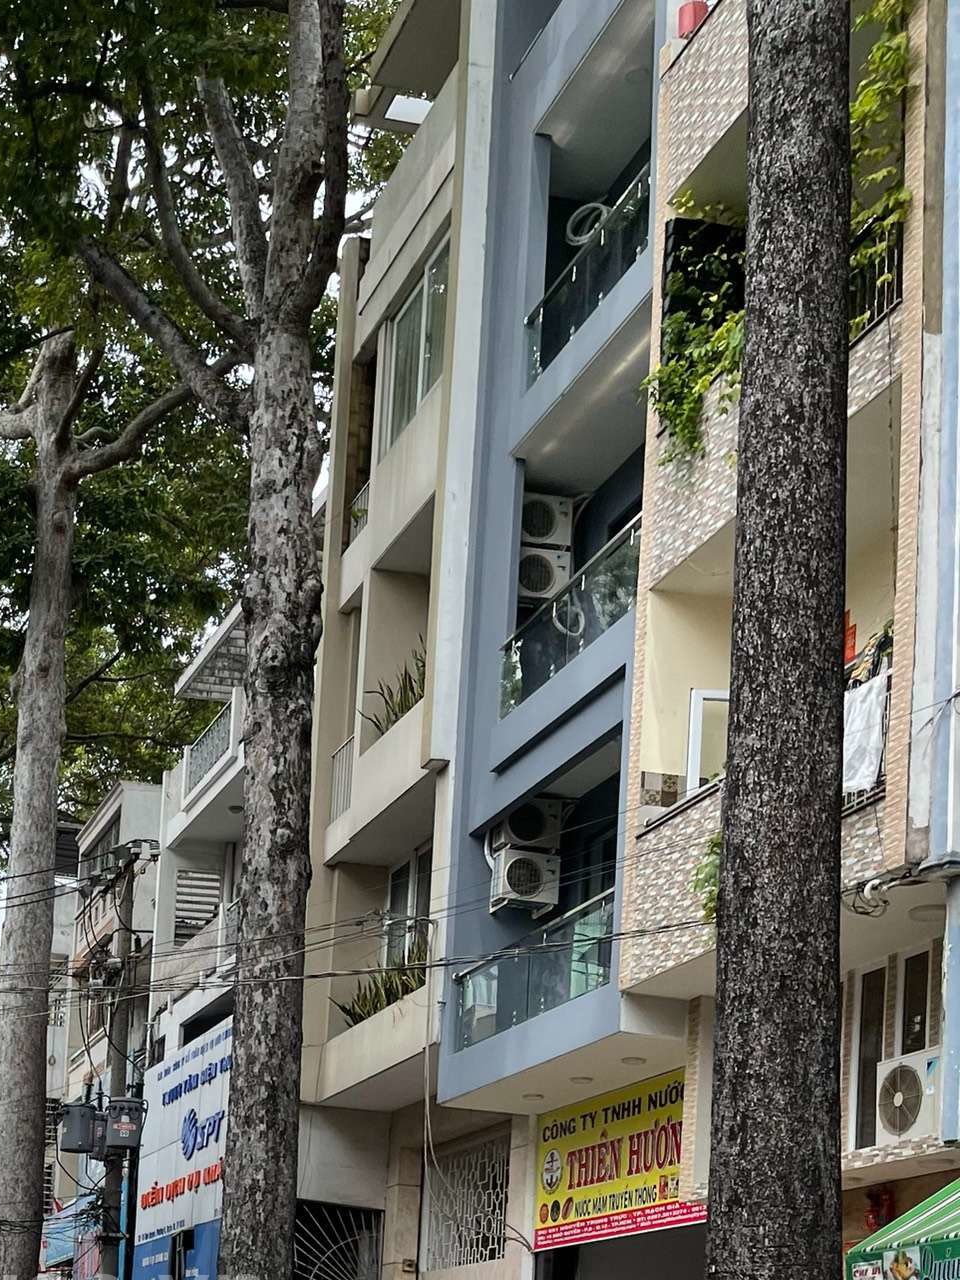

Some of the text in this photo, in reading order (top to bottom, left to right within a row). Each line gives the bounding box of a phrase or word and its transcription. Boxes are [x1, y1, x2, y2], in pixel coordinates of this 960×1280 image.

[196, 1110, 225, 1151] SPT
[542, 1119, 577, 1143] CÔNG
[580, 1111, 598, 1131] TY
[602, 1097, 642, 1125] TNHH
[566, 1115, 683, 1191] THIÊN HƯƠN
